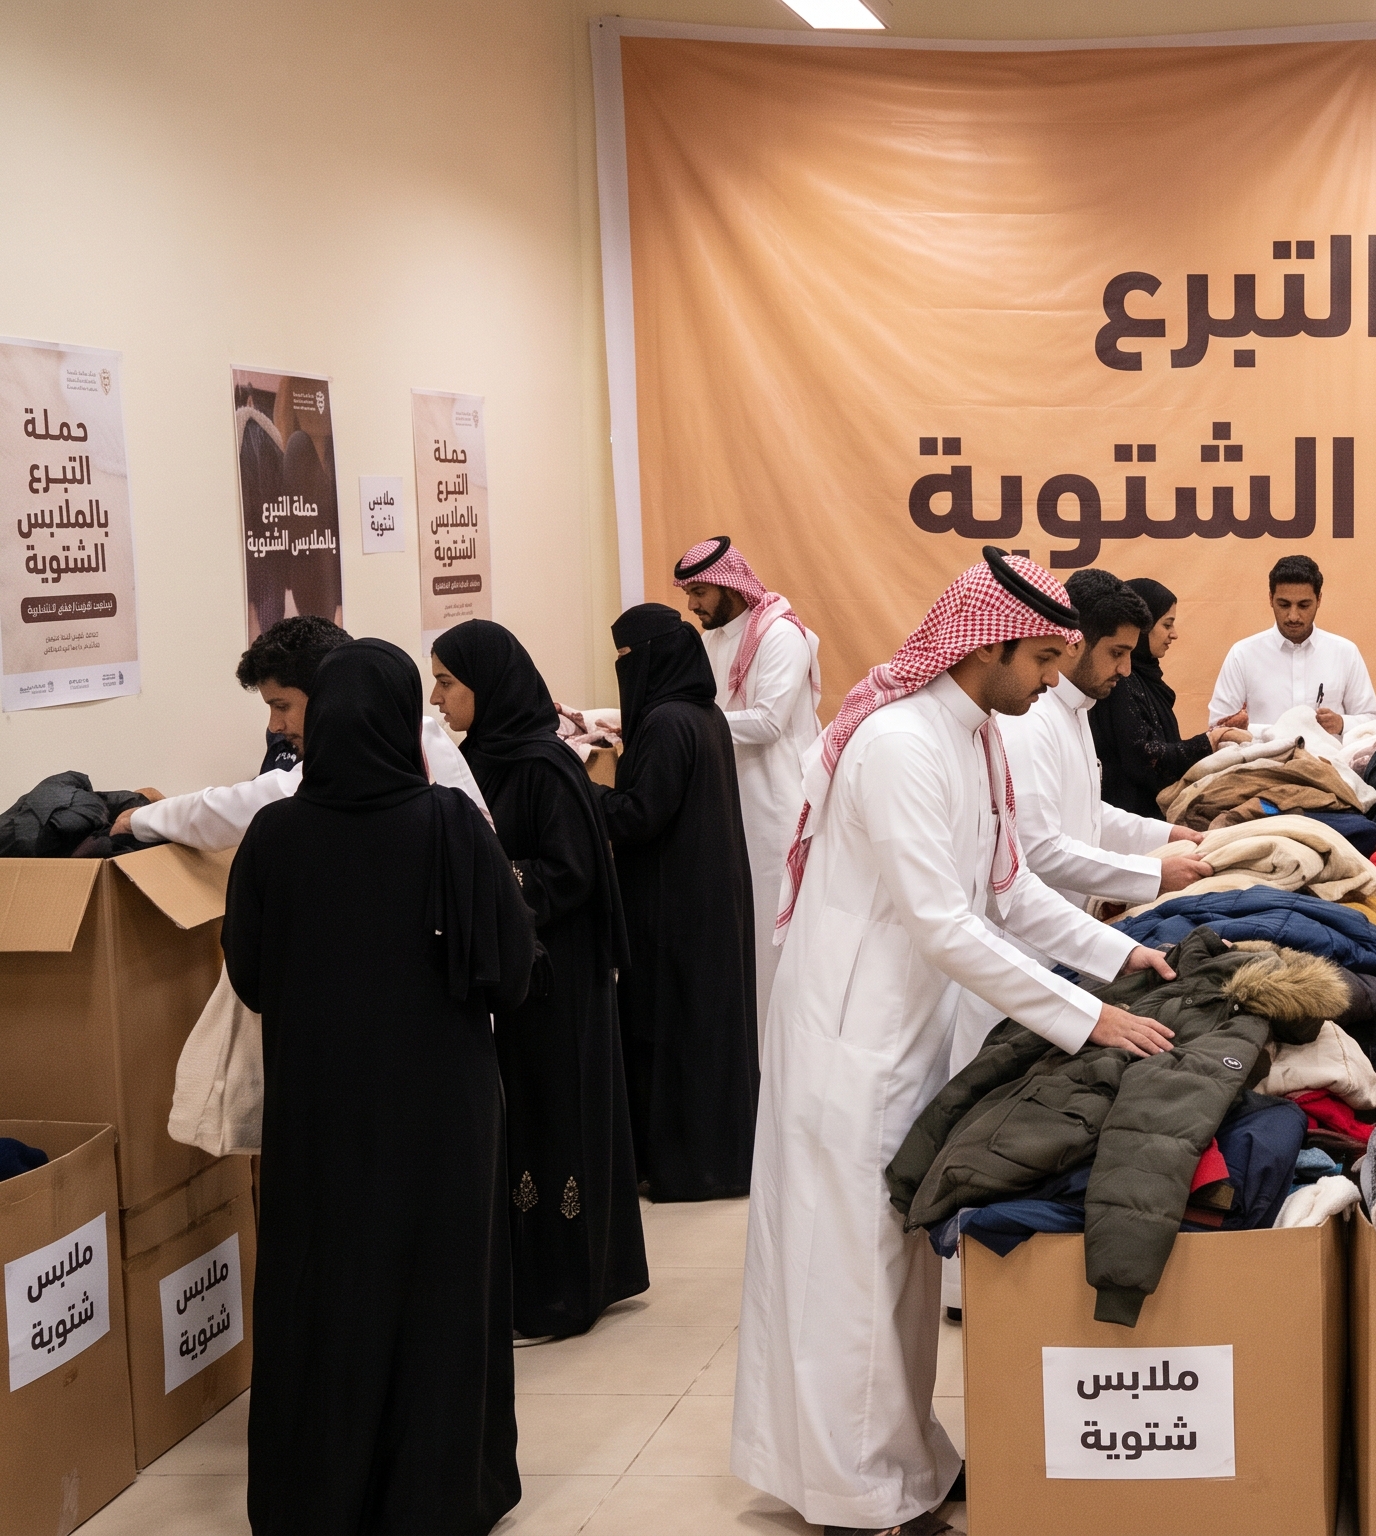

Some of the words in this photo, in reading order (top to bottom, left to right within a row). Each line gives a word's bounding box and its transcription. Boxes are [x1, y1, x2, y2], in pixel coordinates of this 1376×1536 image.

[23, 407, 88, 443] حملة
[433, 439, 468, 465] حملة
[28, 455, 92, 495] التبرع
[436, 473, 469, 504] التبرع
[292, 495, 319, 517] حملة
[909, 422, 1354, 569] الشتوية
[17, 498, 109, 540] بالملابس
[430, 505, 478, 536] بالملابس
[25, 538, 107, 584] الشتوية
[246, 527, 289, 558] الشتوية
[291, 529, 337, 556] بالملابس
[434, 537, 477, 568] الشتوية
[27, 1241, 94, 1303] ملابس
[176, 1259, 229, 1315] ملابس
[31, 1290, 94, 1355] شتوية
[178, 1303, 231, 1361] شتوية
[1076, 1360, 1199, 1400] ملابس
[1080, 1415, 1197, 1461] شتوية
